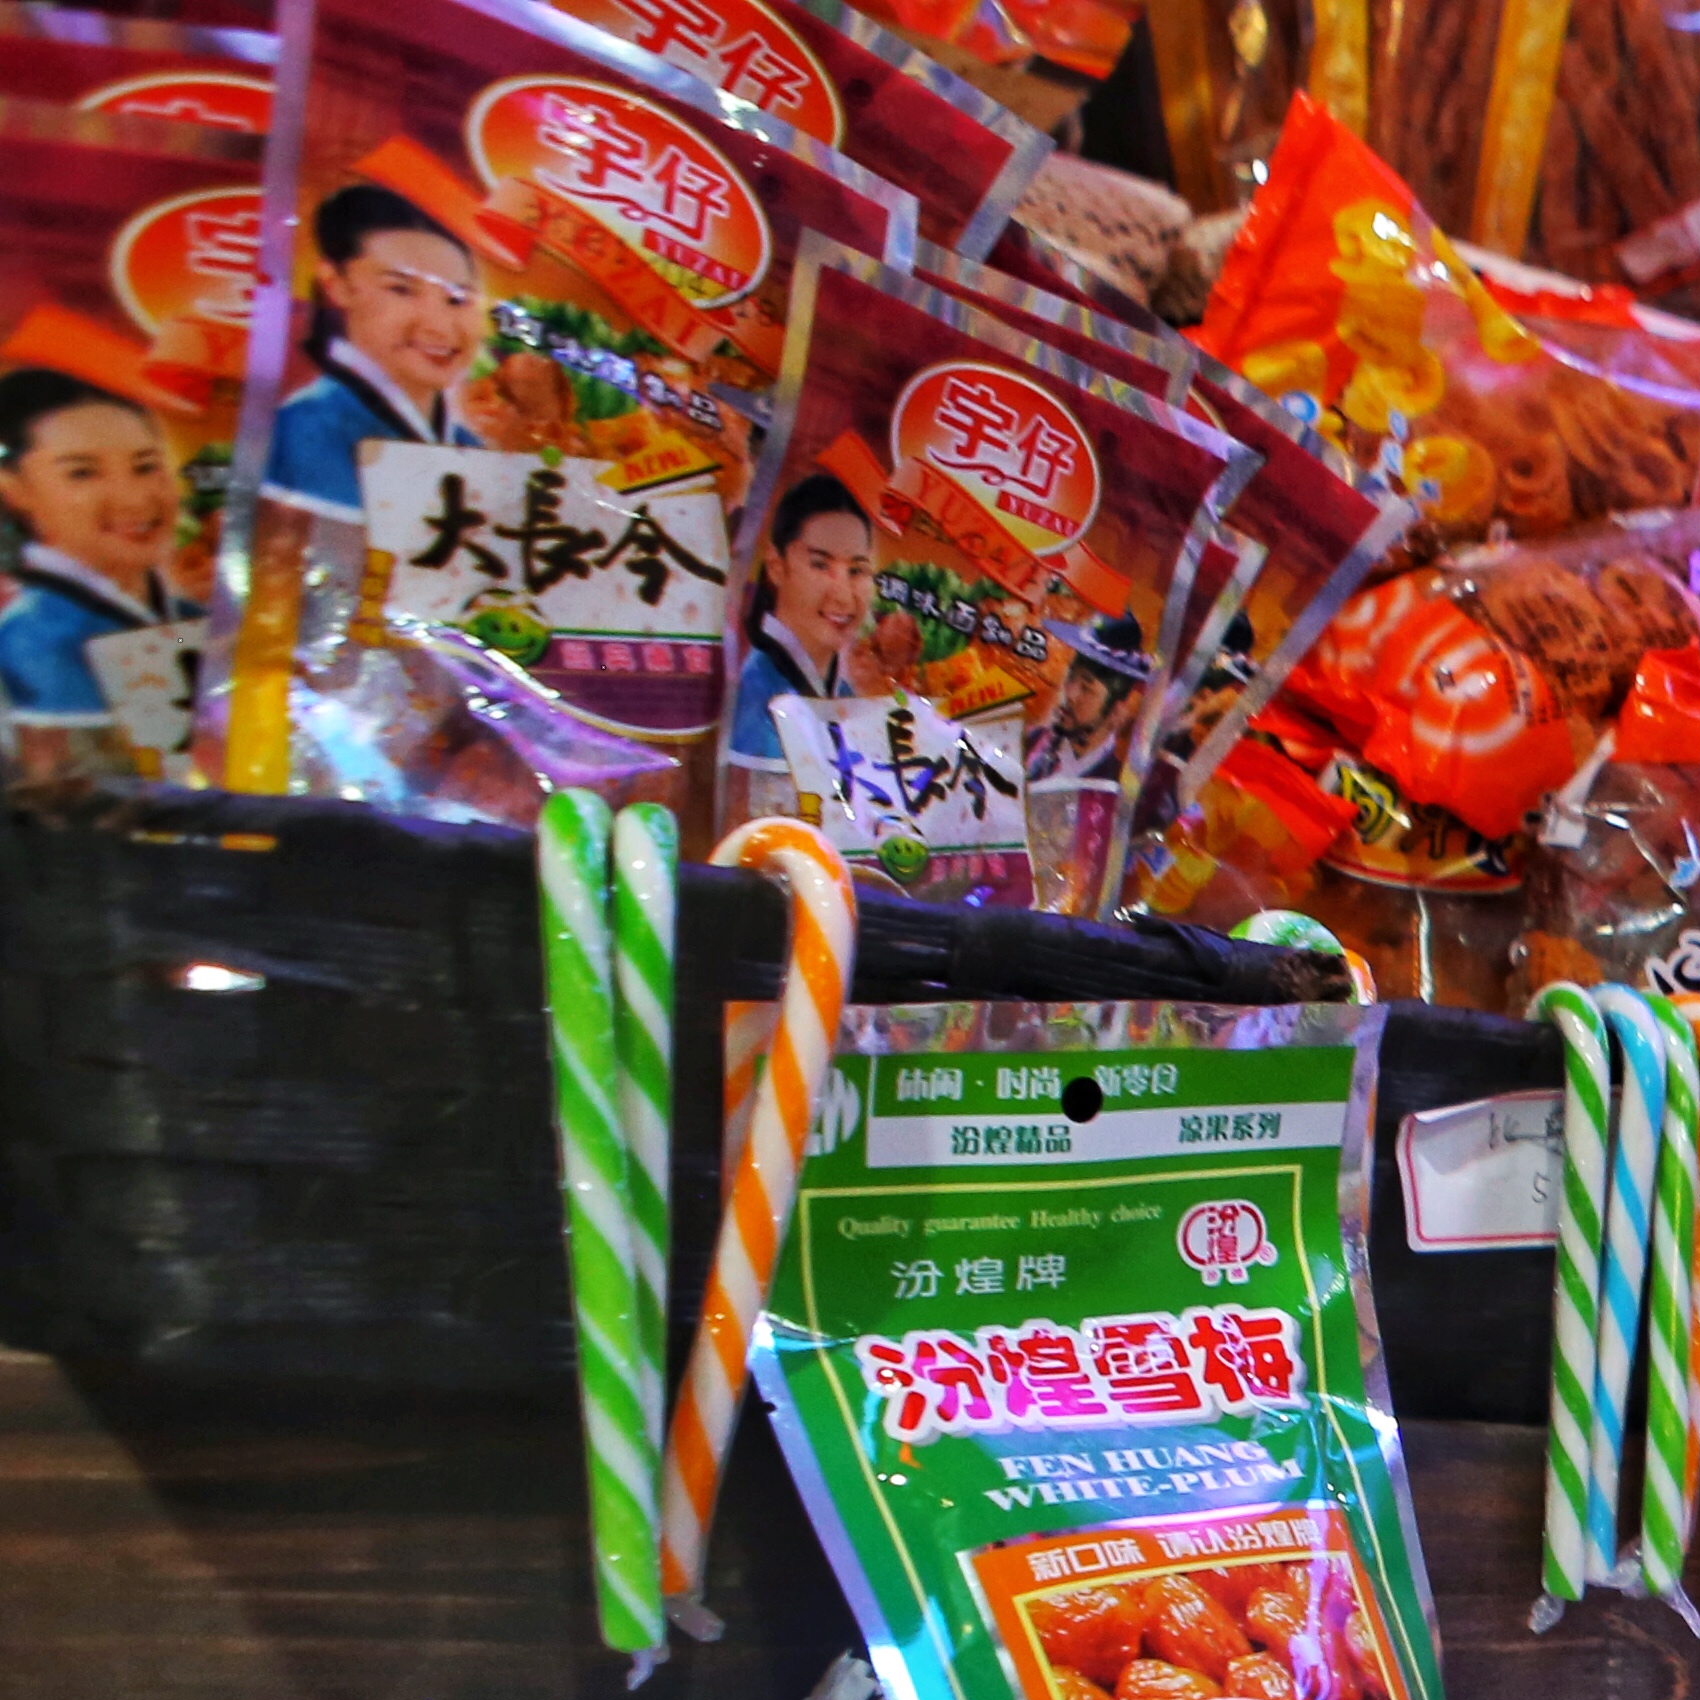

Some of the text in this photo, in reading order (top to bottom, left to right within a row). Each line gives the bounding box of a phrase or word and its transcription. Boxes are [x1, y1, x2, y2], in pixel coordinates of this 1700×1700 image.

[536, 92, 730, 246] 宇仔
[936, 376, 1077, 498] 宇仔
[410, 470, 727, 606] 大長今
[950, 1124, 1072, 1156] 汾煌精品
[837, 1202, 1163, 1240] Quality guarantee Healthy choice
[891, 1254, 1067, 1300] 汾煌牌
[859, 1308, 1305, 1440] 汾煌雪梅
[983, 1458, 1306, 1513] WHITE-PLUM
[998, 1440, 1271, 1482] FEN HUANG
[1025, 1538, 1148, 1582] 新口味
